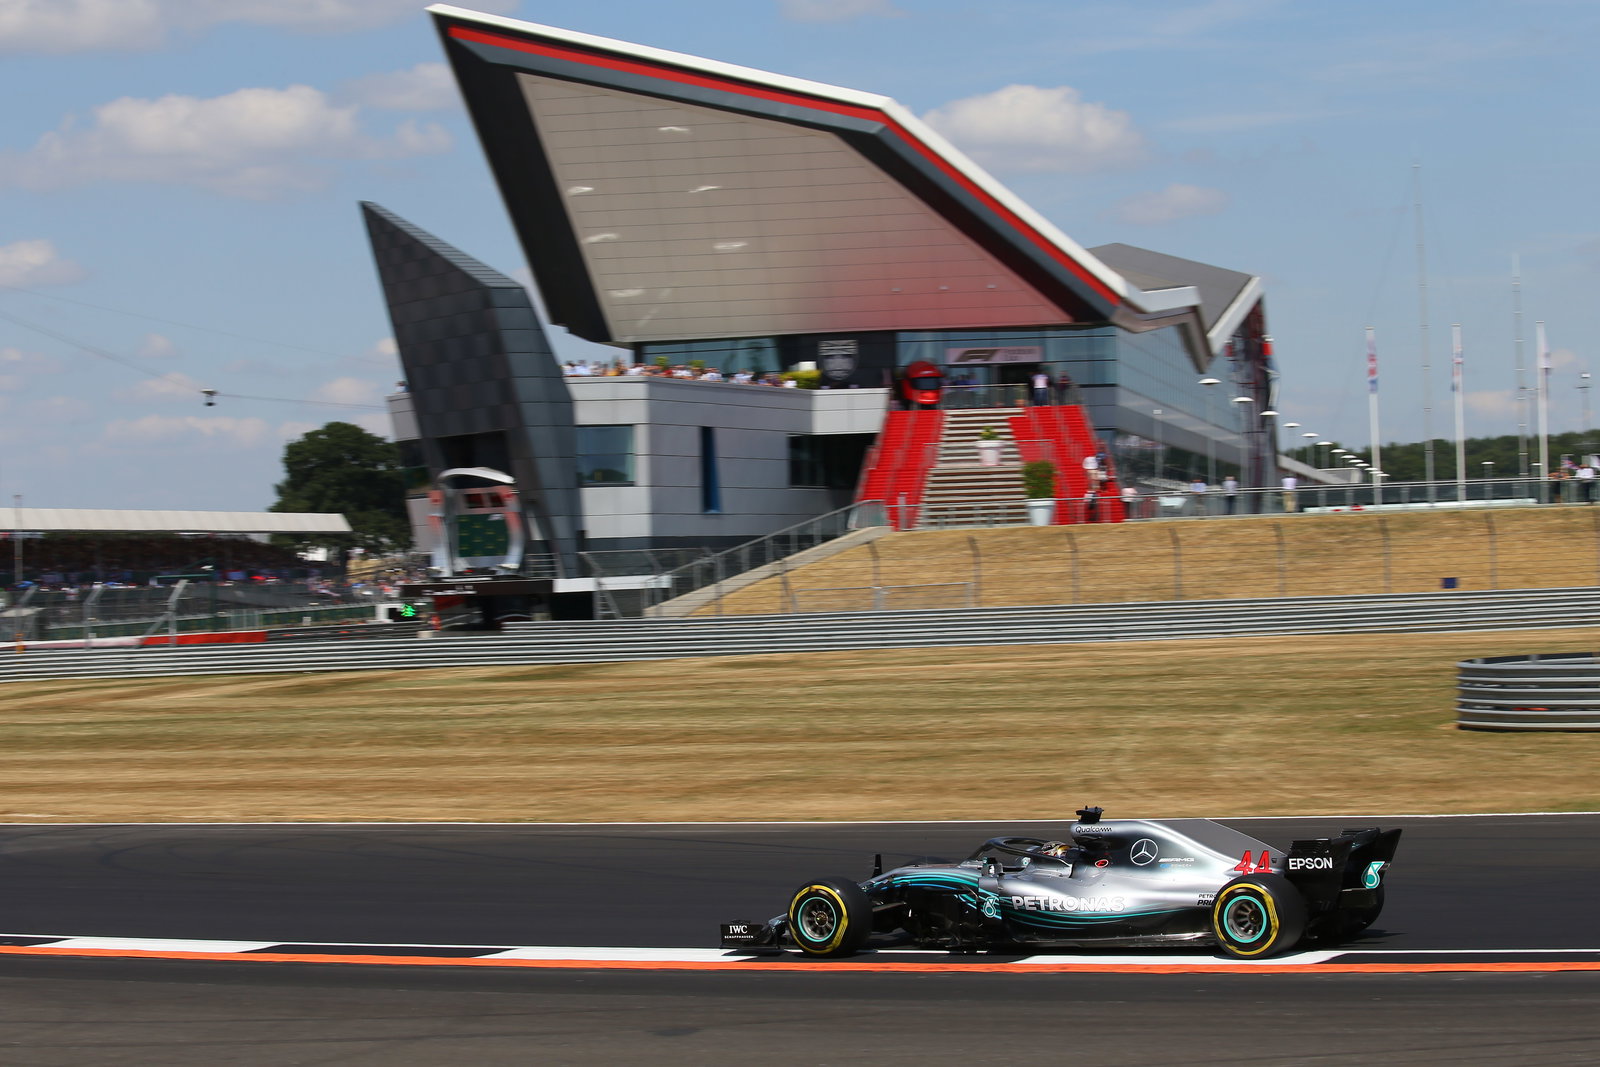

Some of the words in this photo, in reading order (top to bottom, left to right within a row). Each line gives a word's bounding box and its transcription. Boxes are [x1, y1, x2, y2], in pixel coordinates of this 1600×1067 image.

[1234, 850, 1273, 875] 44
[1288, 857, 1333, 870] EPSON
[1011, 895, 1126, 912] PETRONAS
[729, 925, 748, 934] IWC
